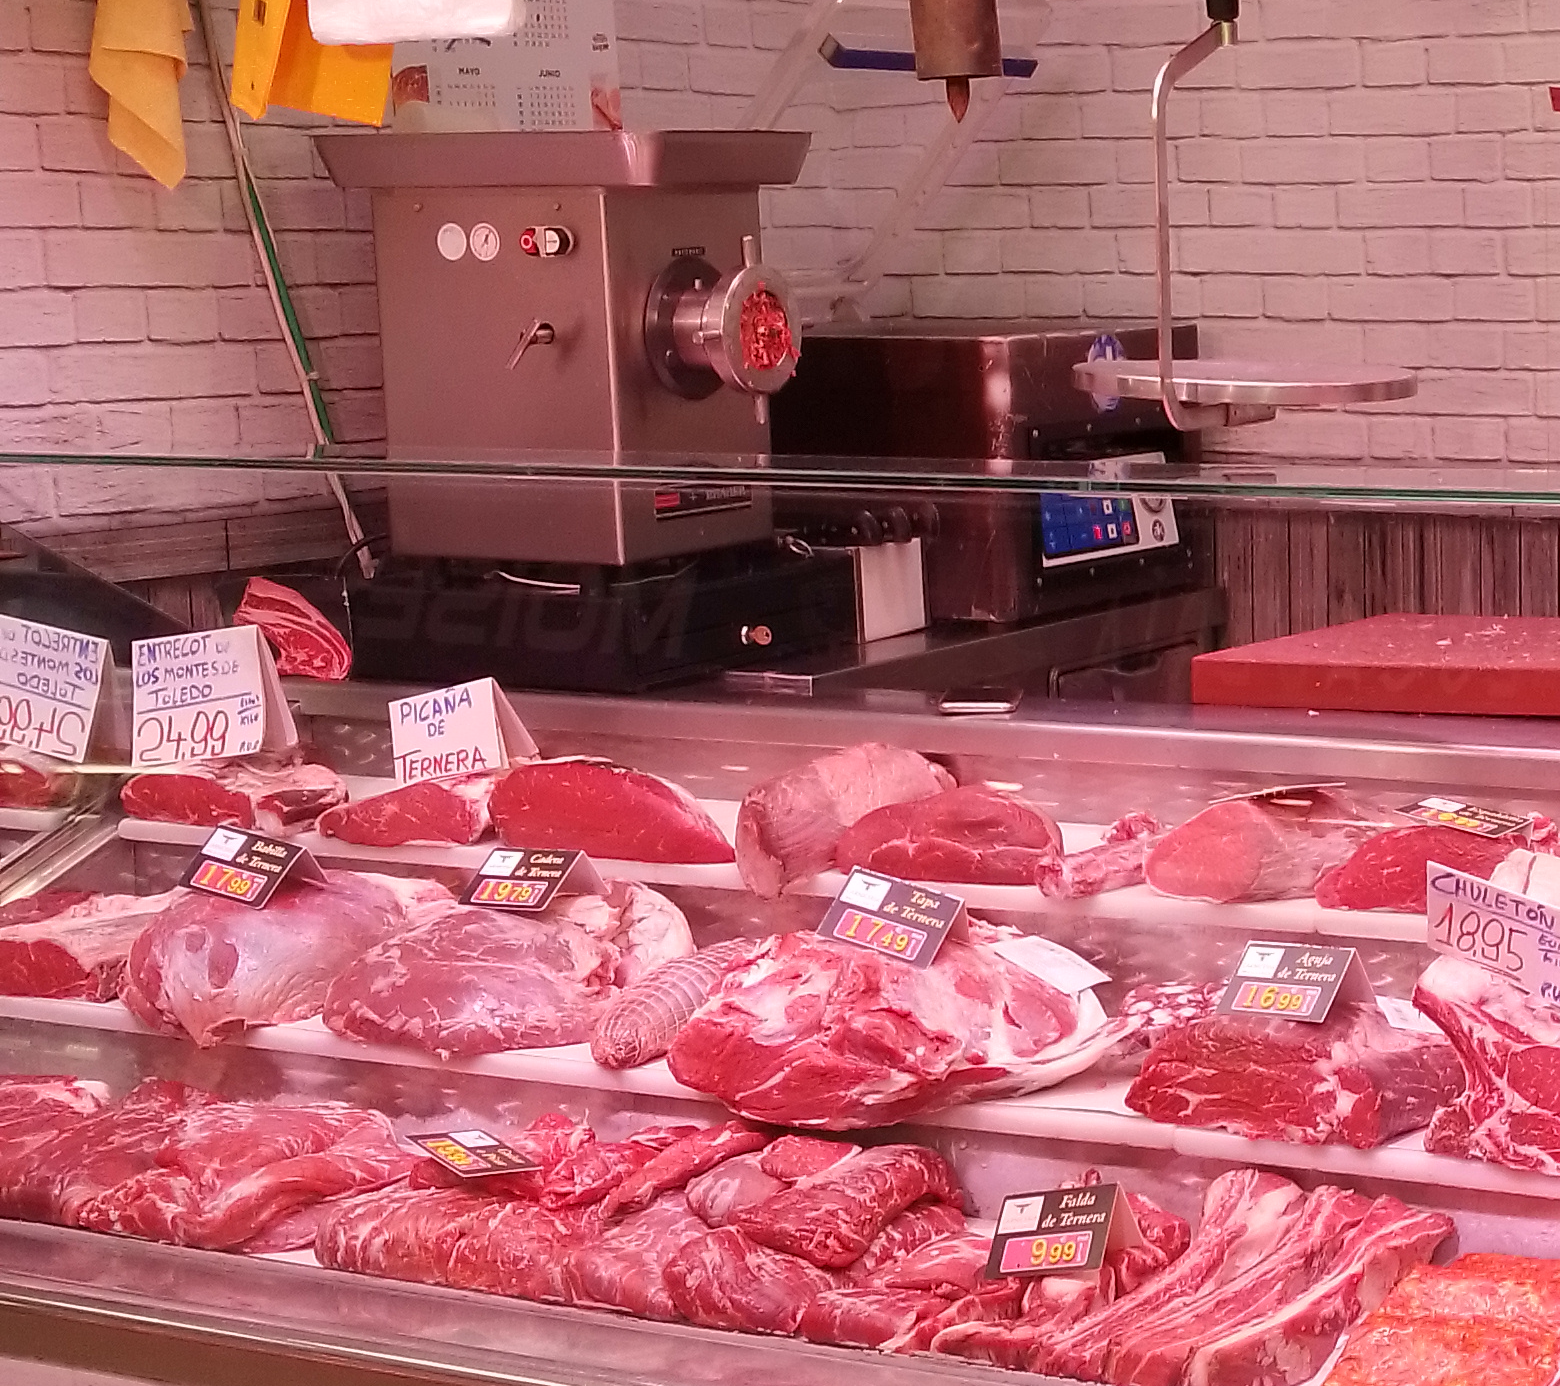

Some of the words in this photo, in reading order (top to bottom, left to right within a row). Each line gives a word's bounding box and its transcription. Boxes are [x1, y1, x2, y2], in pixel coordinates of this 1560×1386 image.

[458, 67, 482, 76] MAYO
[538, 69, 561, 79] JUNIO
[136, 666, 160, 688] LOS
[164, 660, 218, 683] MONTES
[400, 687, 473, 726] PICAÑA
[137, 709, 229, 762] 24,99
[427, 719, 446, 737] DE
[393, 746, 488, 784] TERNERA
[236, 853, 249, 864] de
[515, 866, 528, 877] de
[528, 866, 563, 879] Ternera
[911, 890, 941, 909] Tapa
[883, 901, 899, 915] de
[900, 905, 945, 930] Ternera
[1295, 952, 1334, 968] Aguja
[1277, 966, 1292, 979] de
[1293, 968, 1337, 982] Ternera
[1059, 1192, 1097, 1210] Falda
[1041, 1213, 1057, 1229] de
[1060, 1211, 1106, 1227] Ternera
